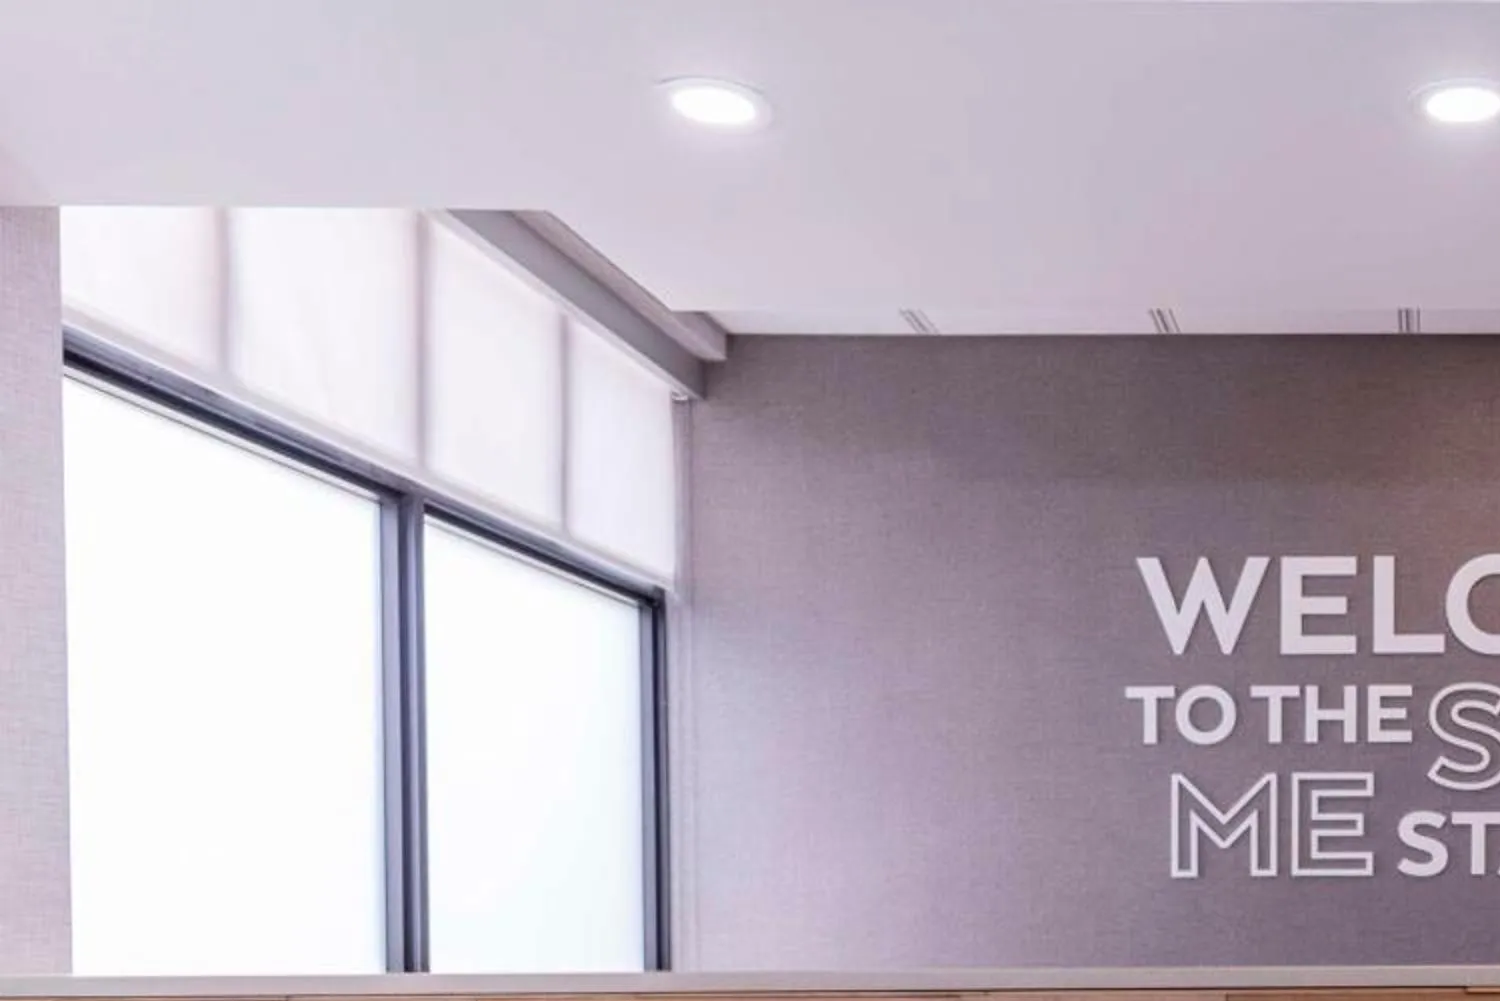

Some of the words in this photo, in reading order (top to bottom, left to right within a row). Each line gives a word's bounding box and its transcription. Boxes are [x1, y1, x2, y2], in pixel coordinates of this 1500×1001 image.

[1125, 685, 1236, 745] TO
[1250, 684, 1413, 744] THE
[1170, 772, 1374, 878] ME
